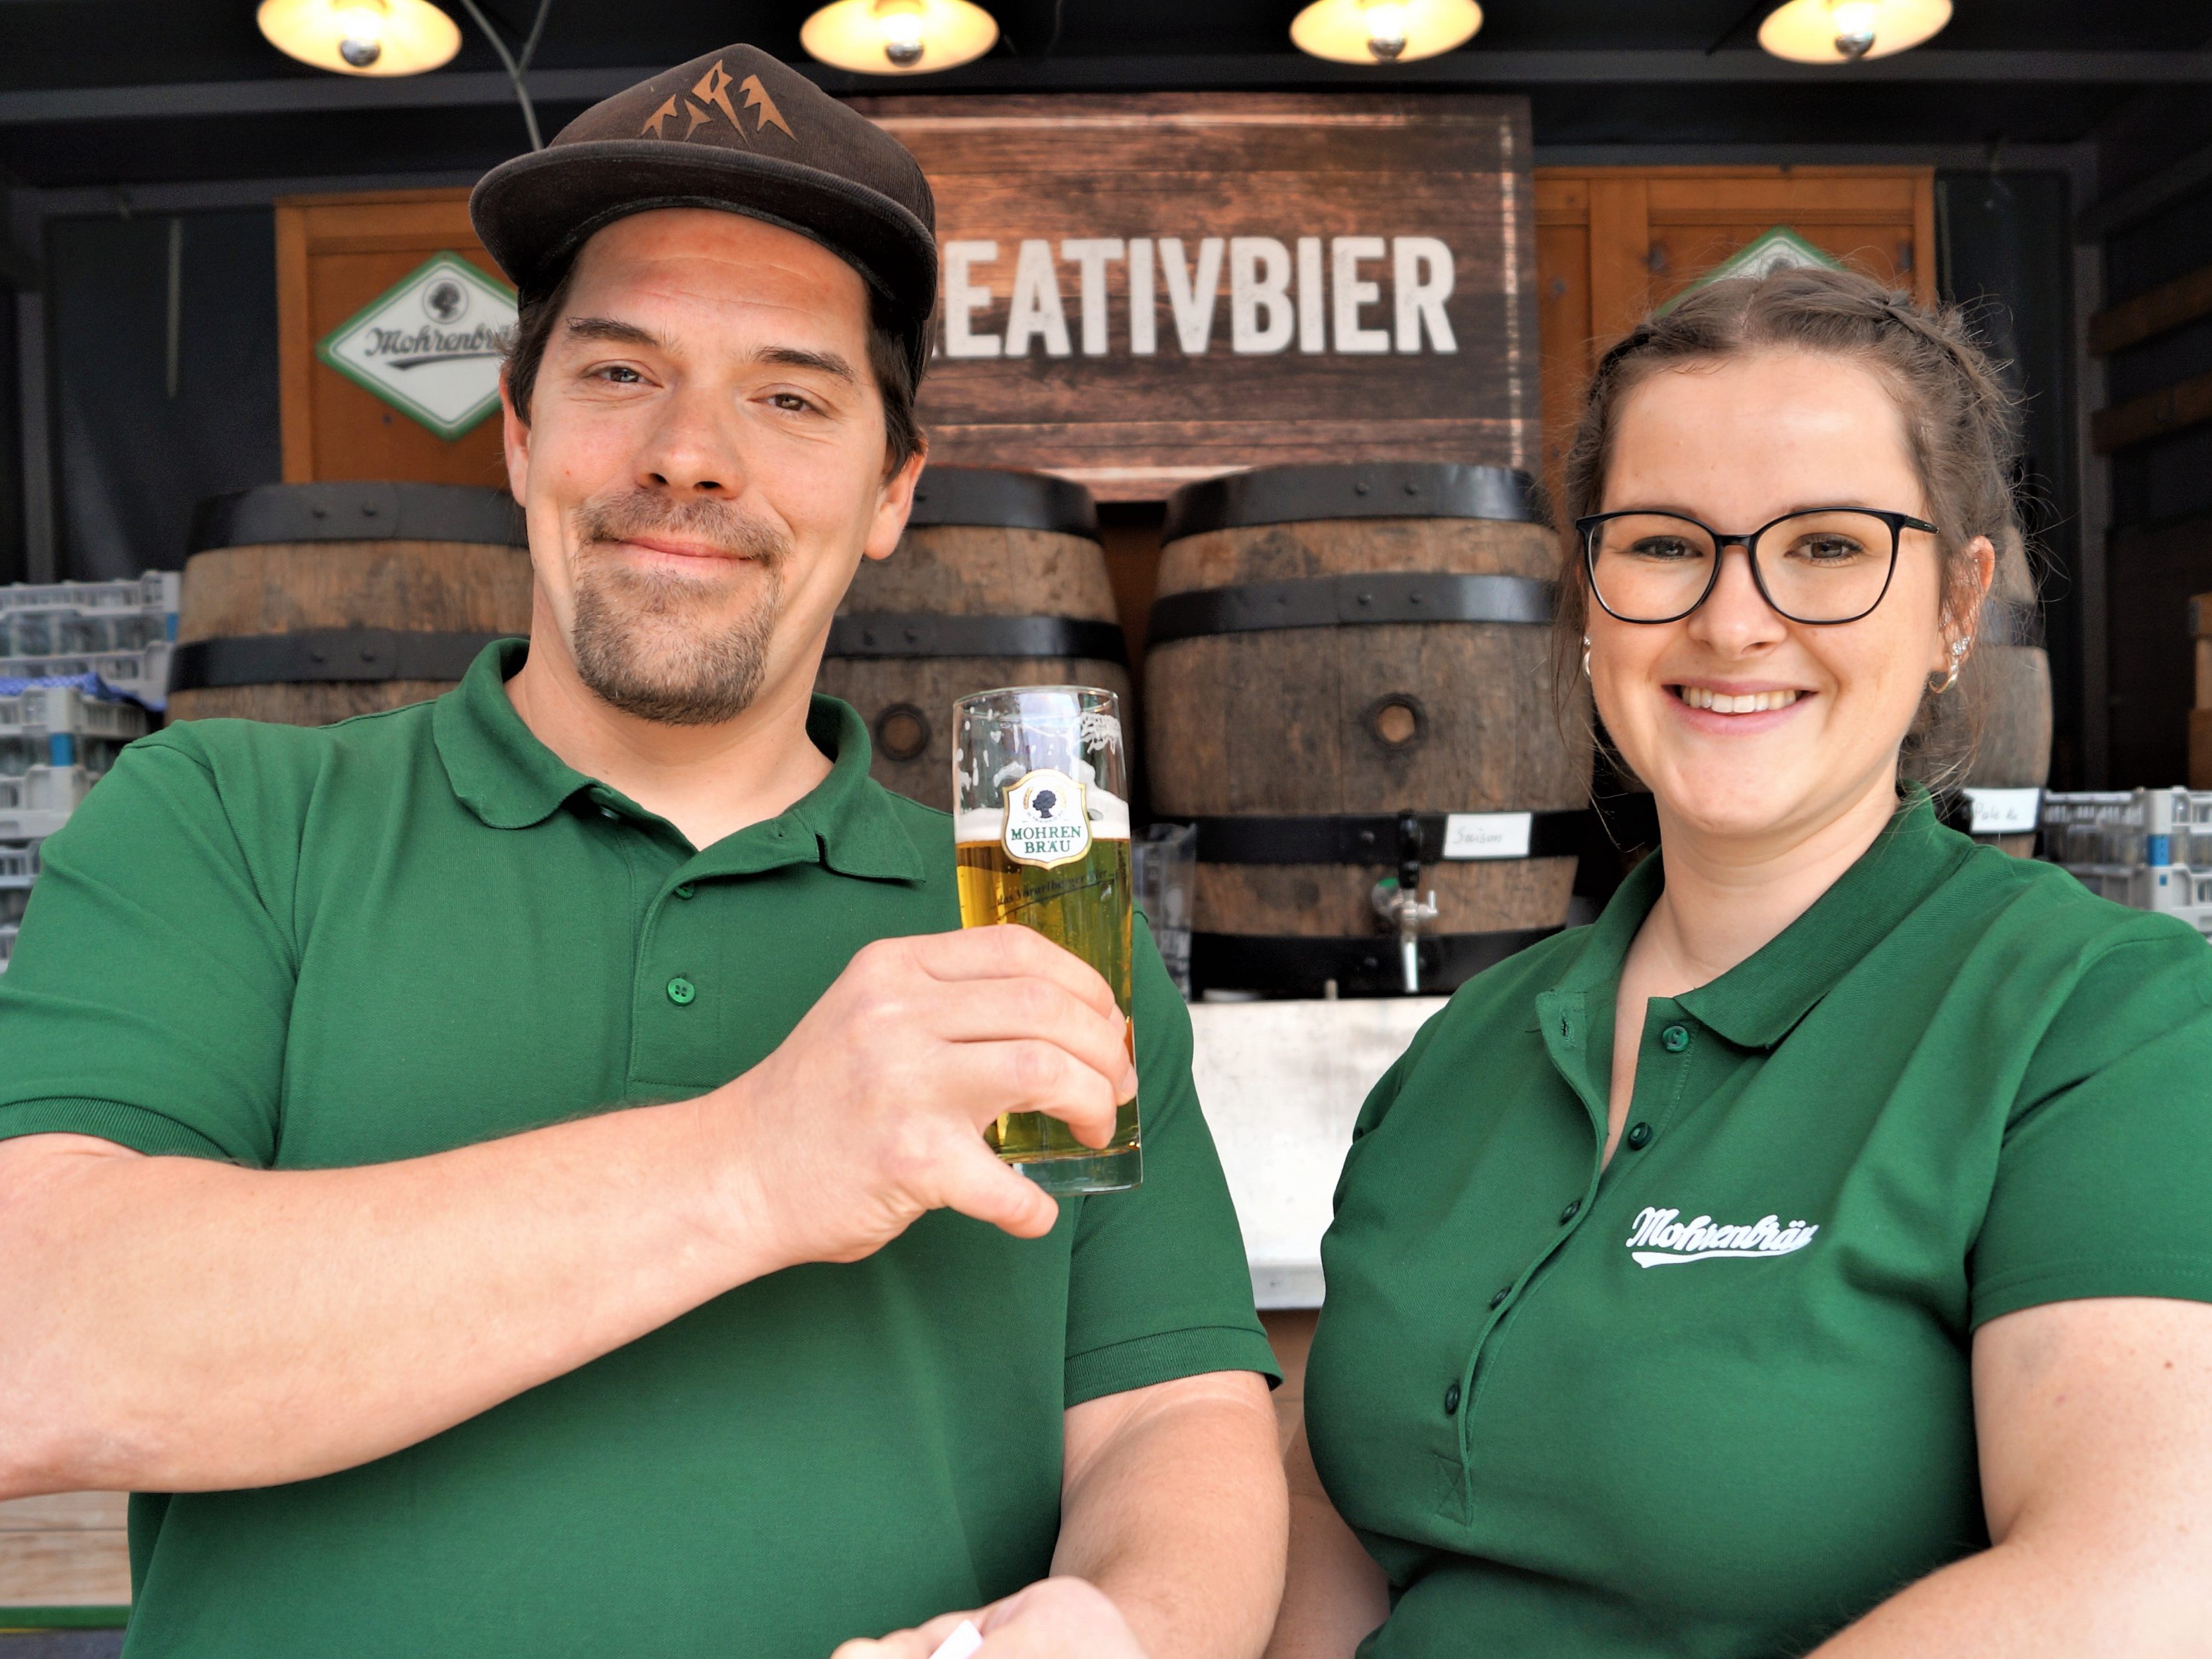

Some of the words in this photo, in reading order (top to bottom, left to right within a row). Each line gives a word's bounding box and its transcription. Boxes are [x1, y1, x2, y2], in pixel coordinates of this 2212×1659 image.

[933, 237, 1458, 358] EATIVBIER
[364, 323, 512, 357] Mohrenbr
[1010, 826, 1081, 840] MOHREN
[1453, 825, 1503, 844] Saison
[1024, 840, 1071, 854] BRÄU
[1626, 1206, 1820, 1252] Mohrenbräu
